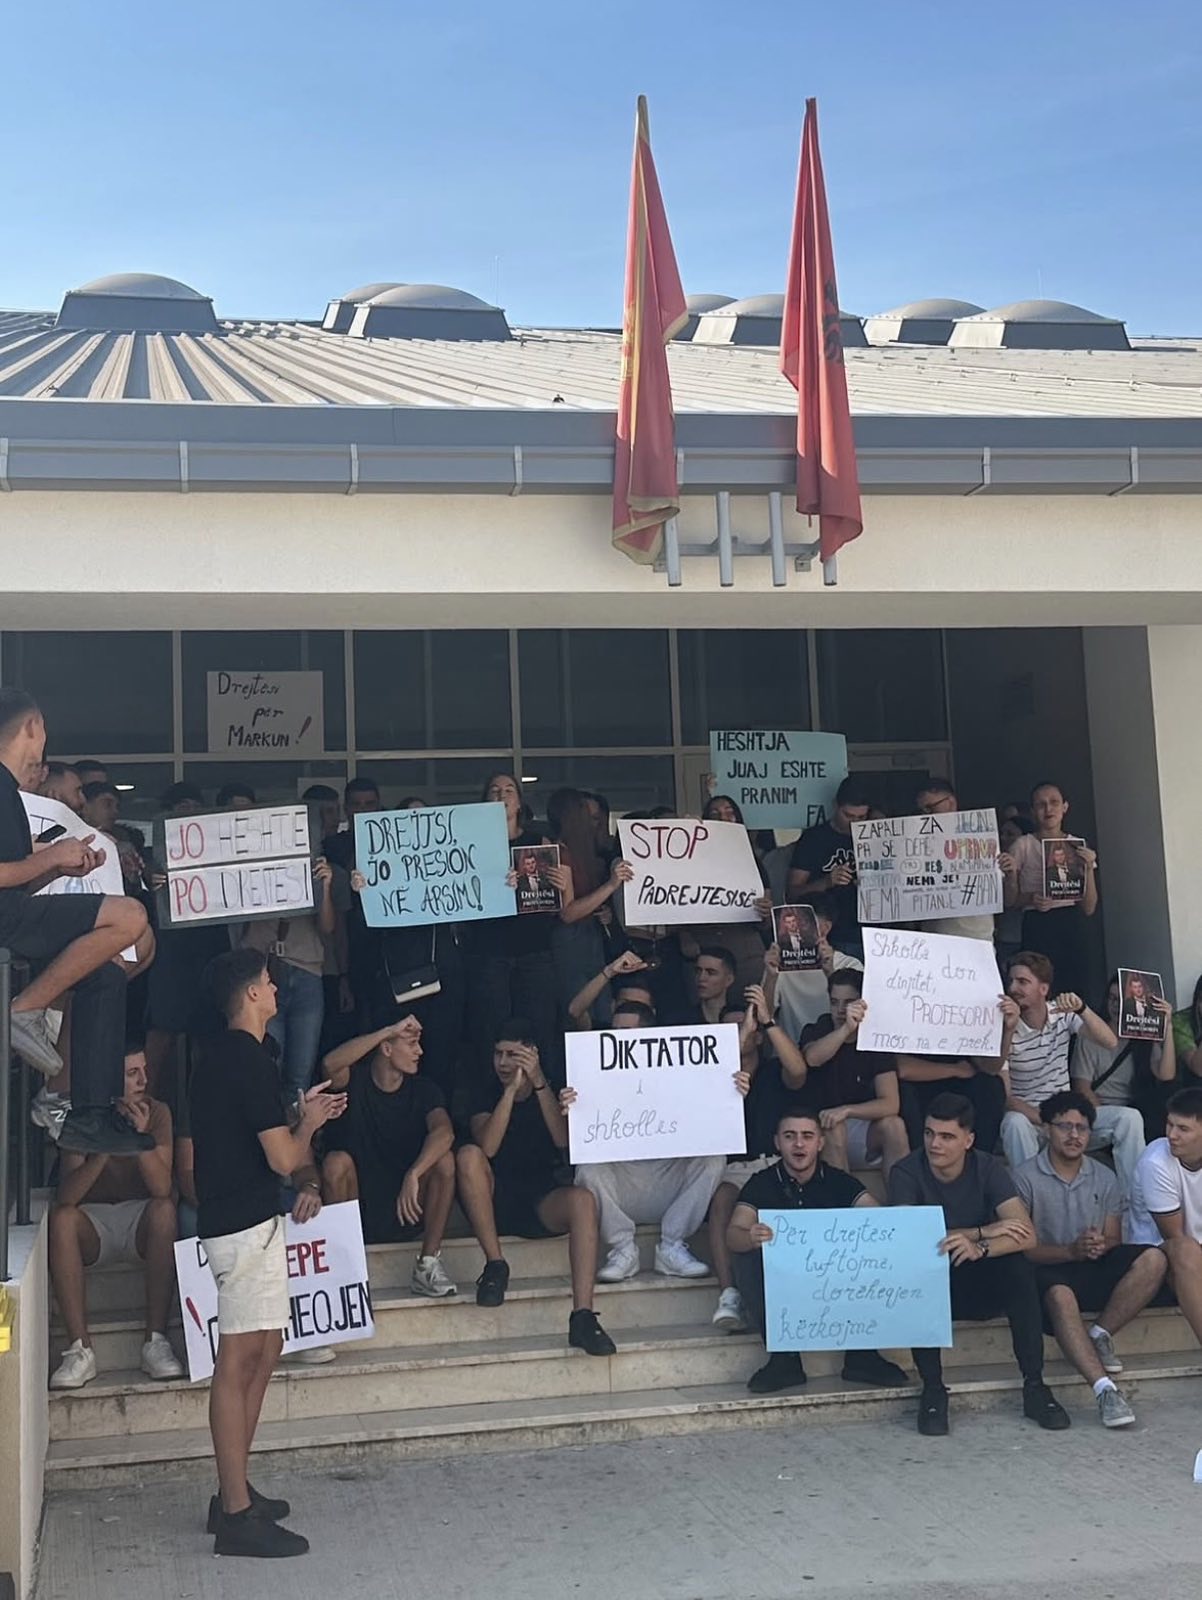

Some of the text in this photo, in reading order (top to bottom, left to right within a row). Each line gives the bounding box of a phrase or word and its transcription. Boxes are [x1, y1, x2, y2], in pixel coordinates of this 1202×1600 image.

[717, 731, 790, 751] HESHTJA
[727, 760, 827, 779] JUAJ ESHTE
[741, 787, 798, 804] PRANIM
[919, 816, 944, 835] ZA
[169, 822, 204, 860] JO
[630, 822, 709, 859] STOP
[171, 875, 207, 915] PO
[600, 1032, 719, 1071] DIKTATOR
